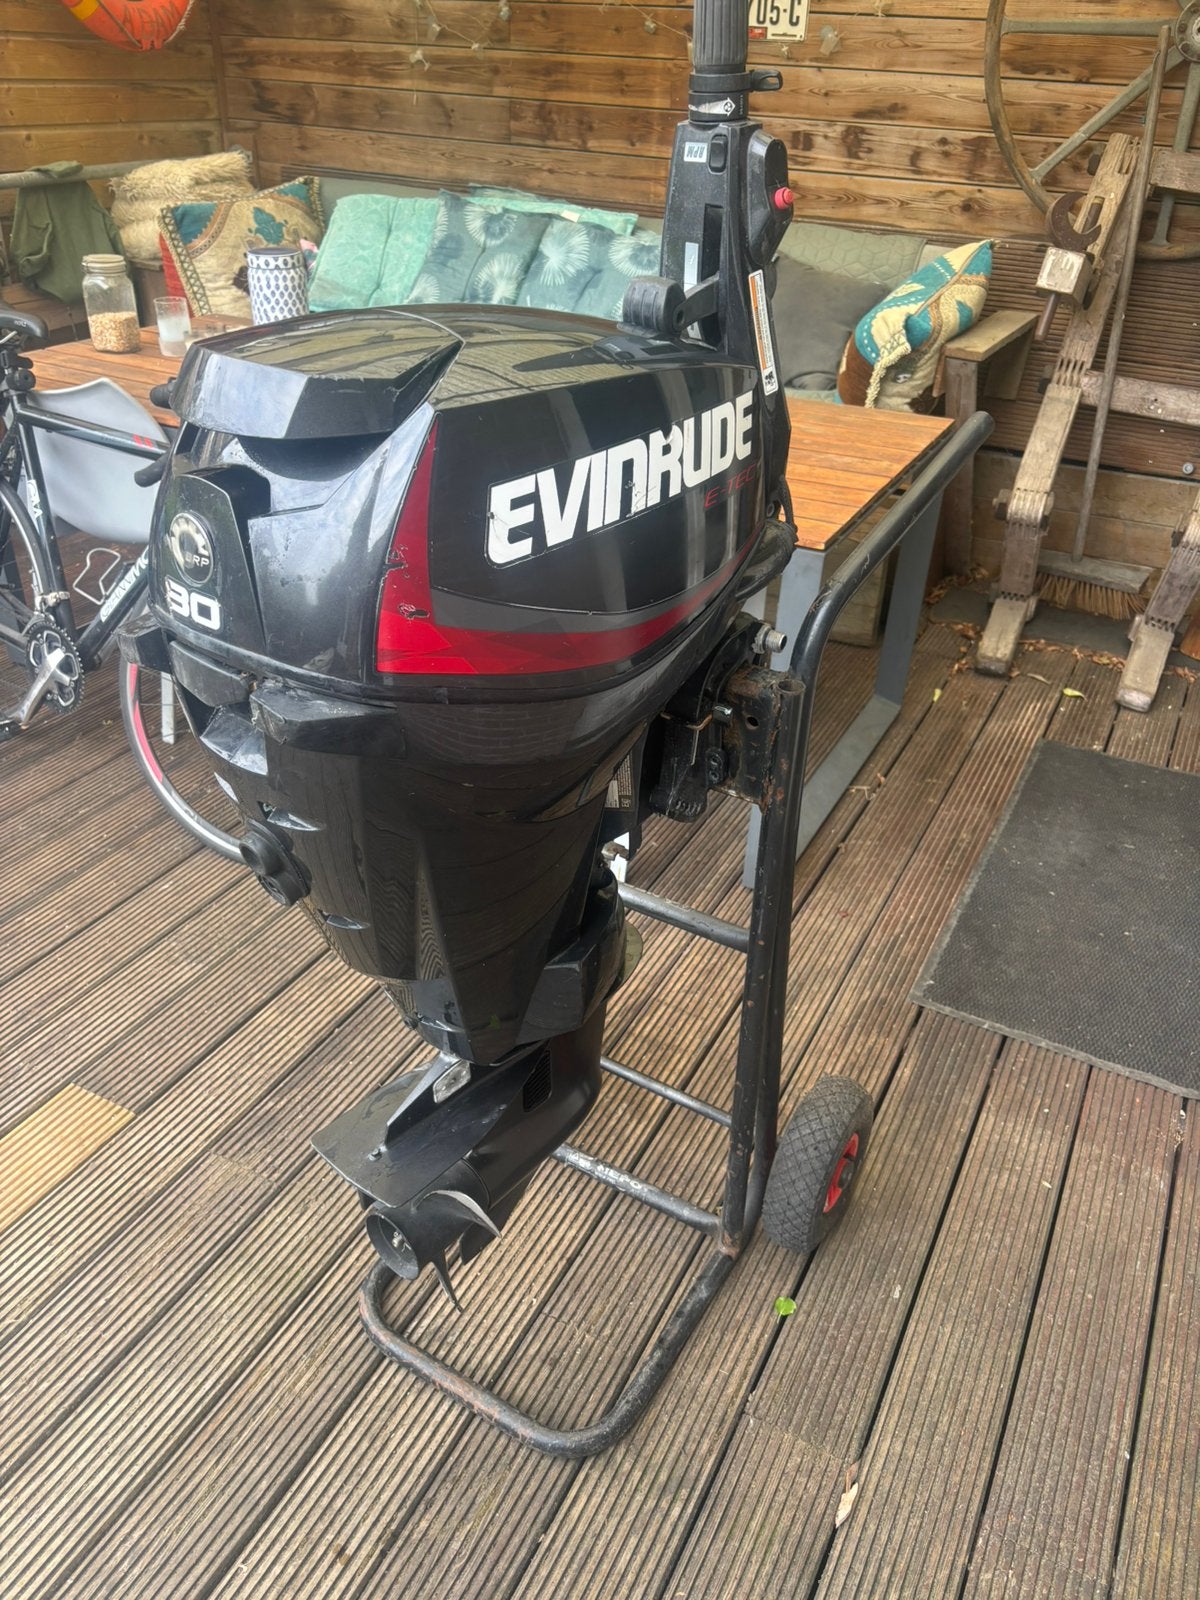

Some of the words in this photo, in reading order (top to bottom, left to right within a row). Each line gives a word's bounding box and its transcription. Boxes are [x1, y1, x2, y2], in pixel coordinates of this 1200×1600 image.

[686, 145, 706, 159] RPM
[487, 390, 753, 565] EVINRUDE
[704, 463, 757, 509] E-TEC
[165, 576, 221, 631] 30
